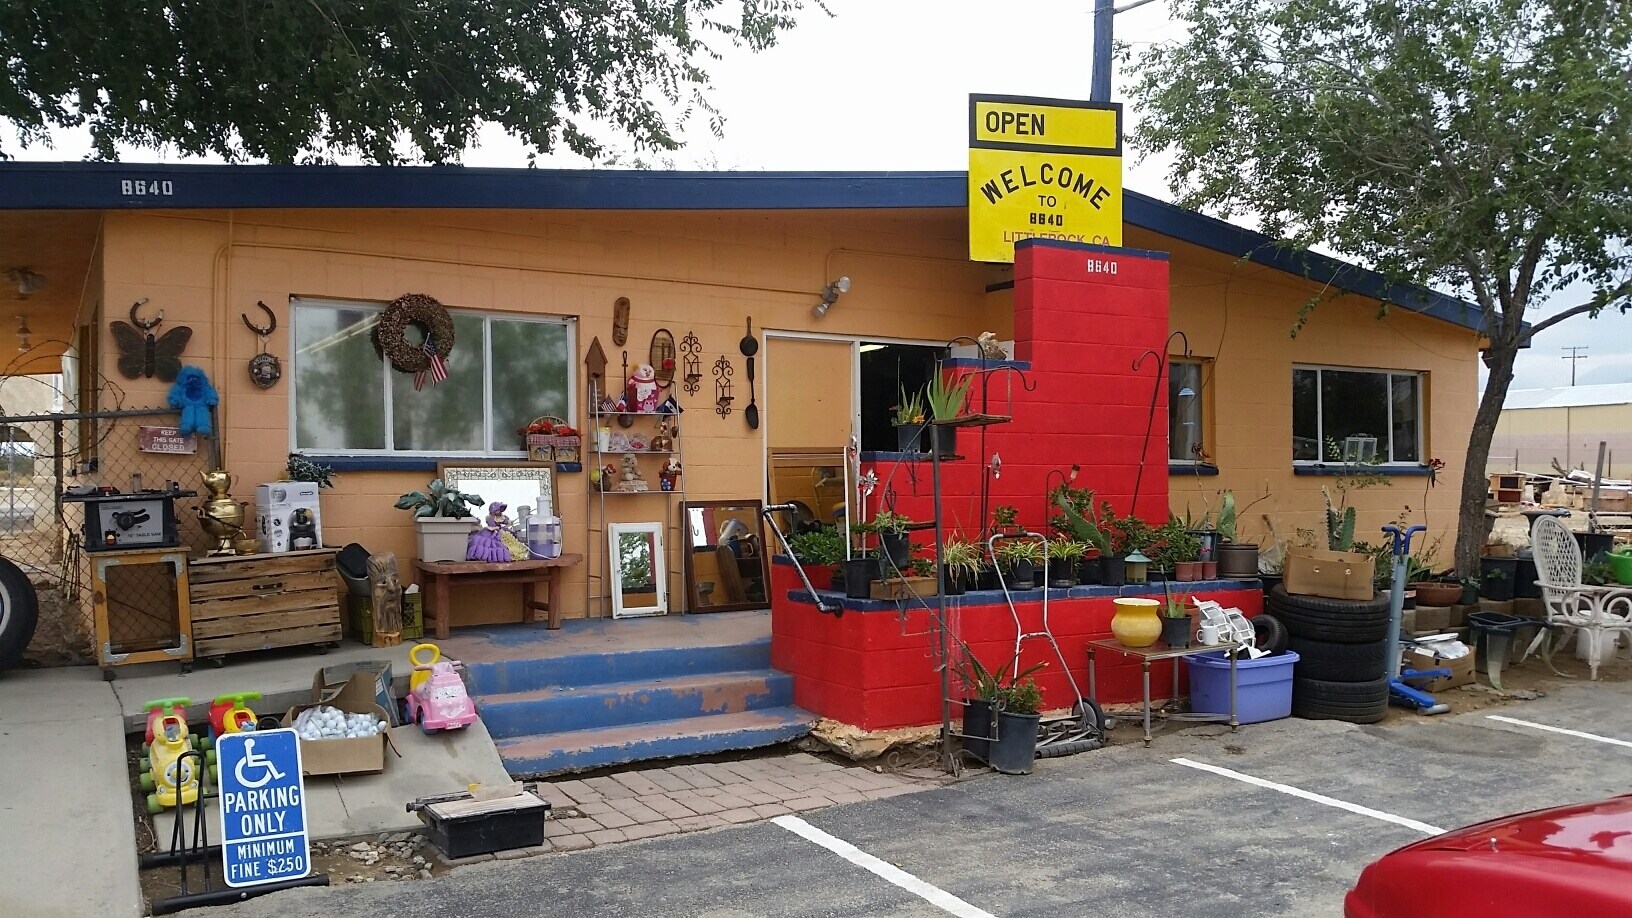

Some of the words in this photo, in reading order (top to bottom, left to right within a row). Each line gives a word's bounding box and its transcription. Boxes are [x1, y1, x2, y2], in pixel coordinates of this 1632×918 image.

[985, 111, 1045, 136] OPEN
[121, 180, 173, 195] 8640
[980, 163, 1111, 210] WELCOME
[1038, 195, 1057, 208] TO
[1029, 212, 1063, 227] 8640
[1087, 259, 1117, 275] 8640
[225, 785, 300, 814] PARKING
[241, 810, 286, 836] ONLY
[237, 839, 295, 860] MINIMUM
[231, 861, 261, 880] FINE
[267, 855, 303, 876] $250
